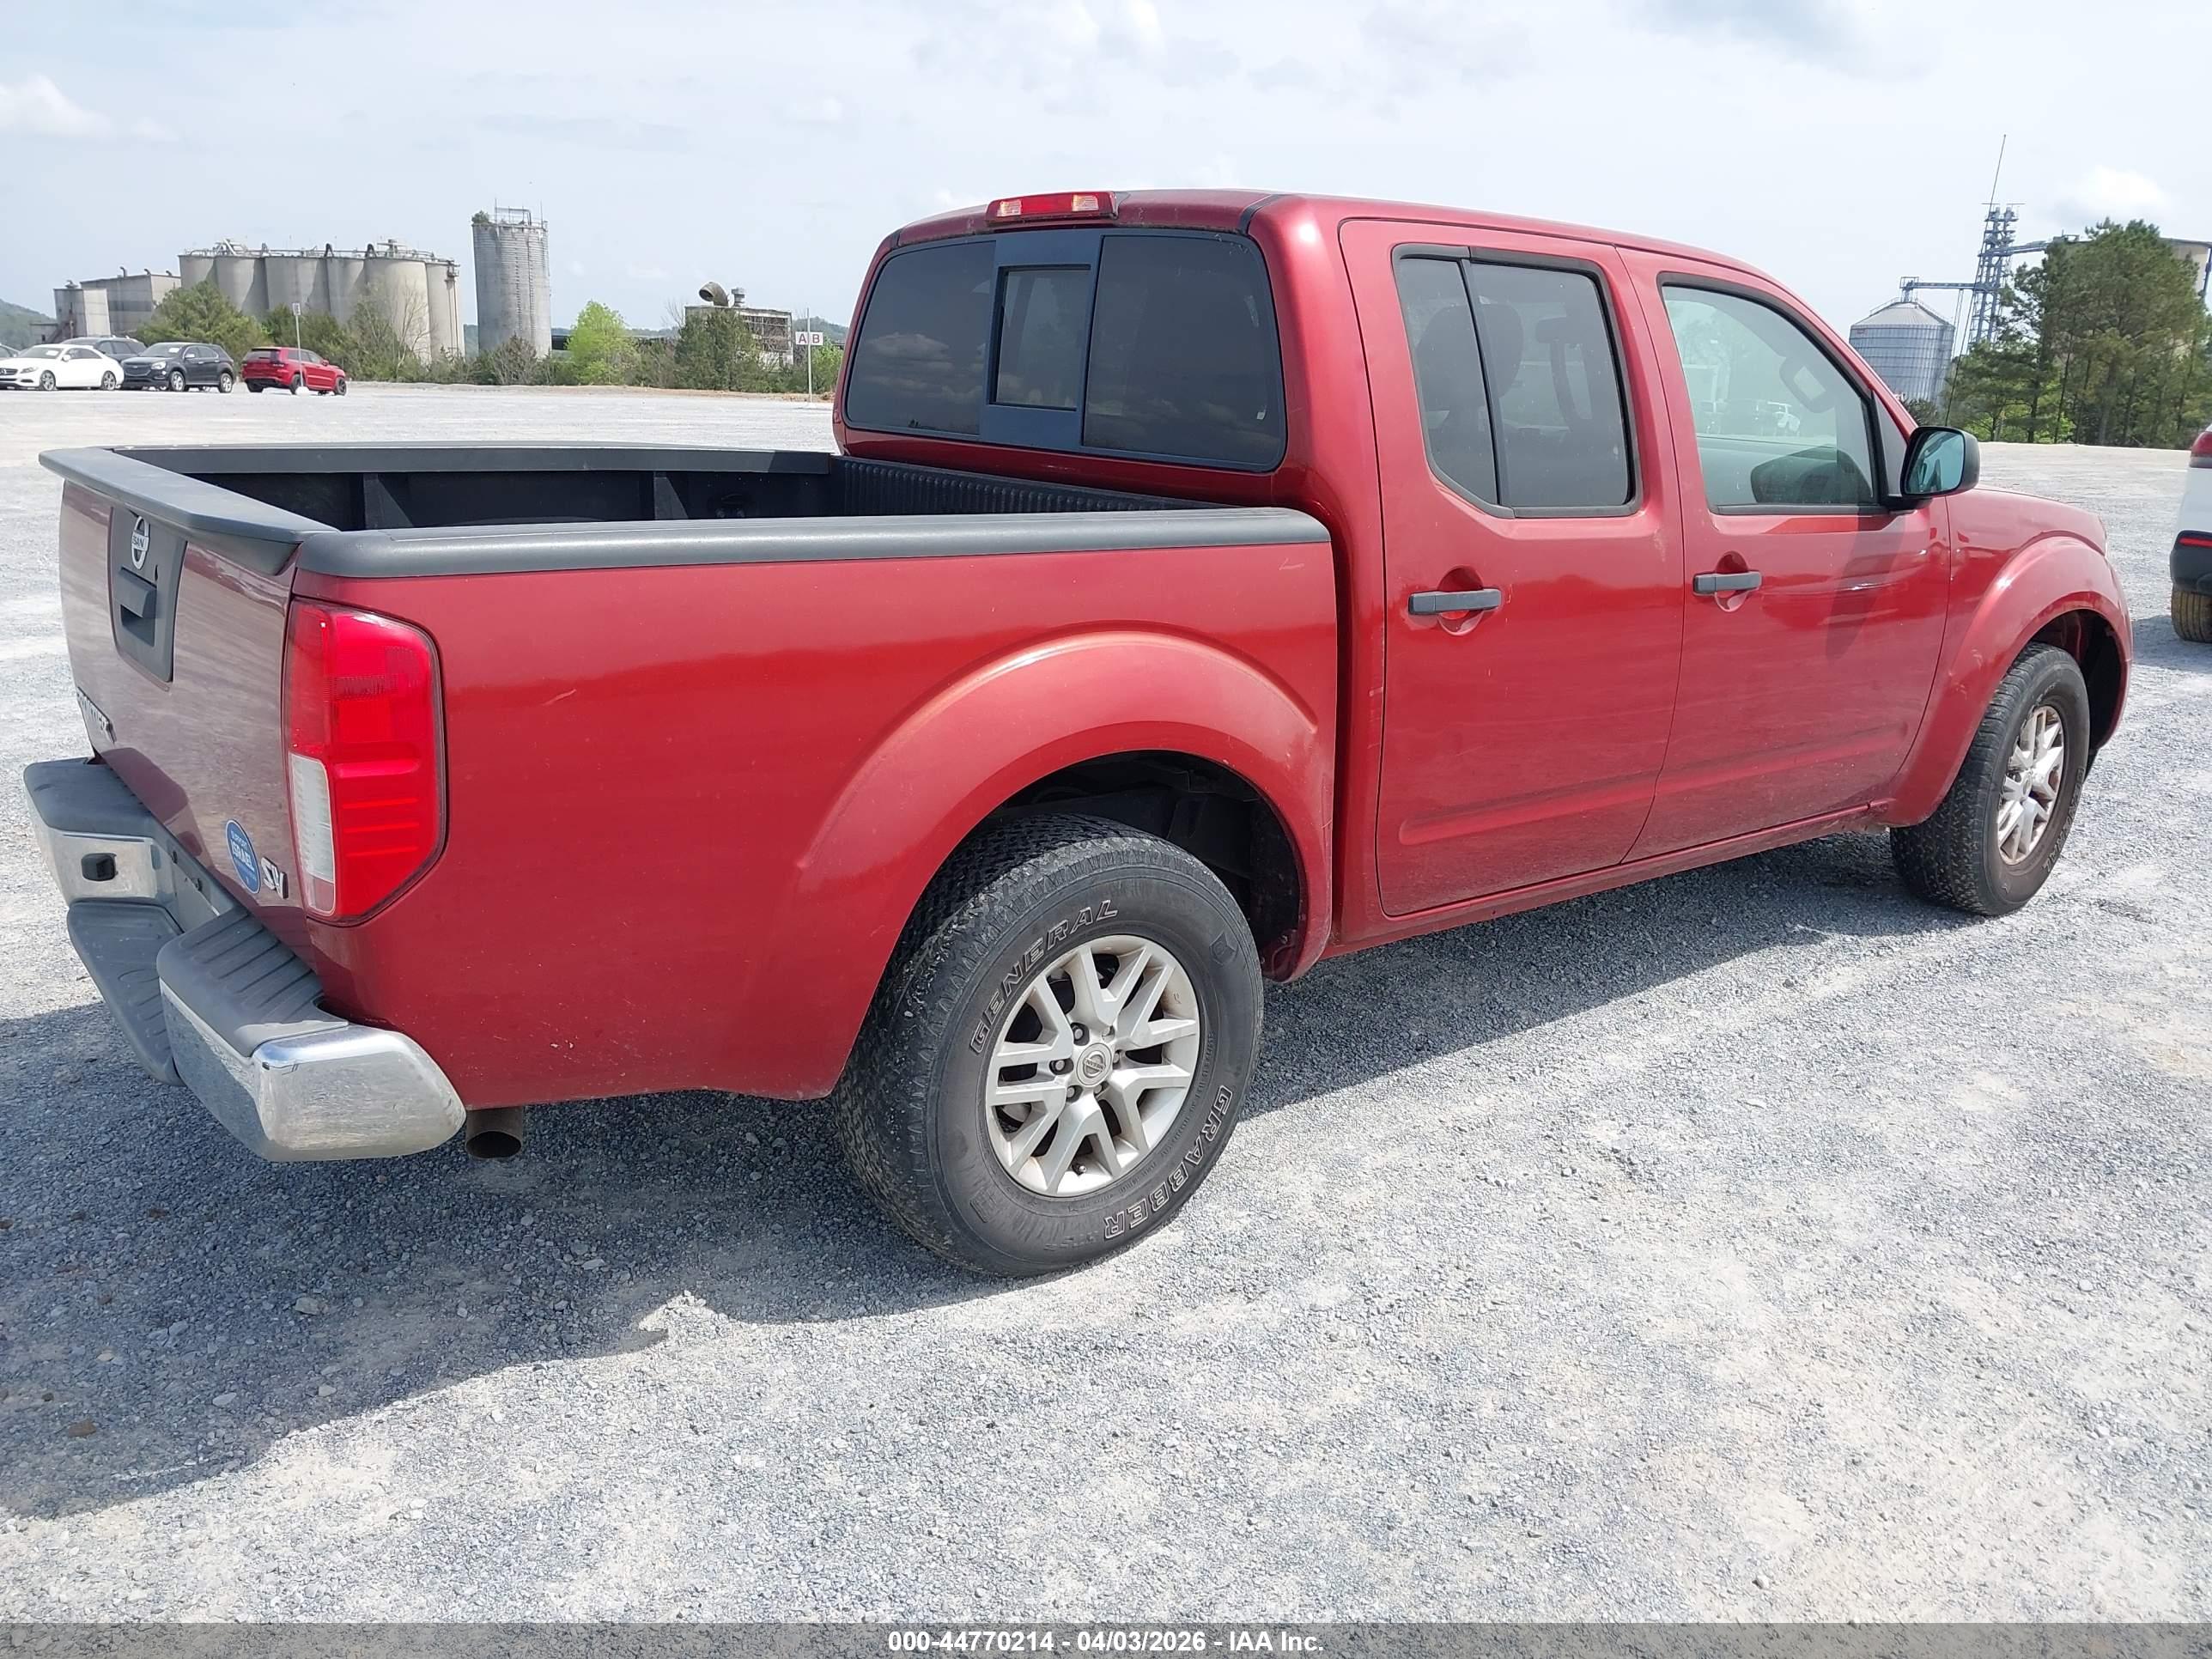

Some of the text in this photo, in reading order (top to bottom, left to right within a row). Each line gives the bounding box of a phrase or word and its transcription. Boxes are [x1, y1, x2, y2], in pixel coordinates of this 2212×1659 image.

[799, 333, 807, 343] A
[812, 334, 820, 343] B
[230, 840, 255, 872] ISRAEL
[260, 856, 286, 899] SV
[969, 899, 1118, 1054] GENERAL
[1103, 1085, 1233, 1240] GRABBER
